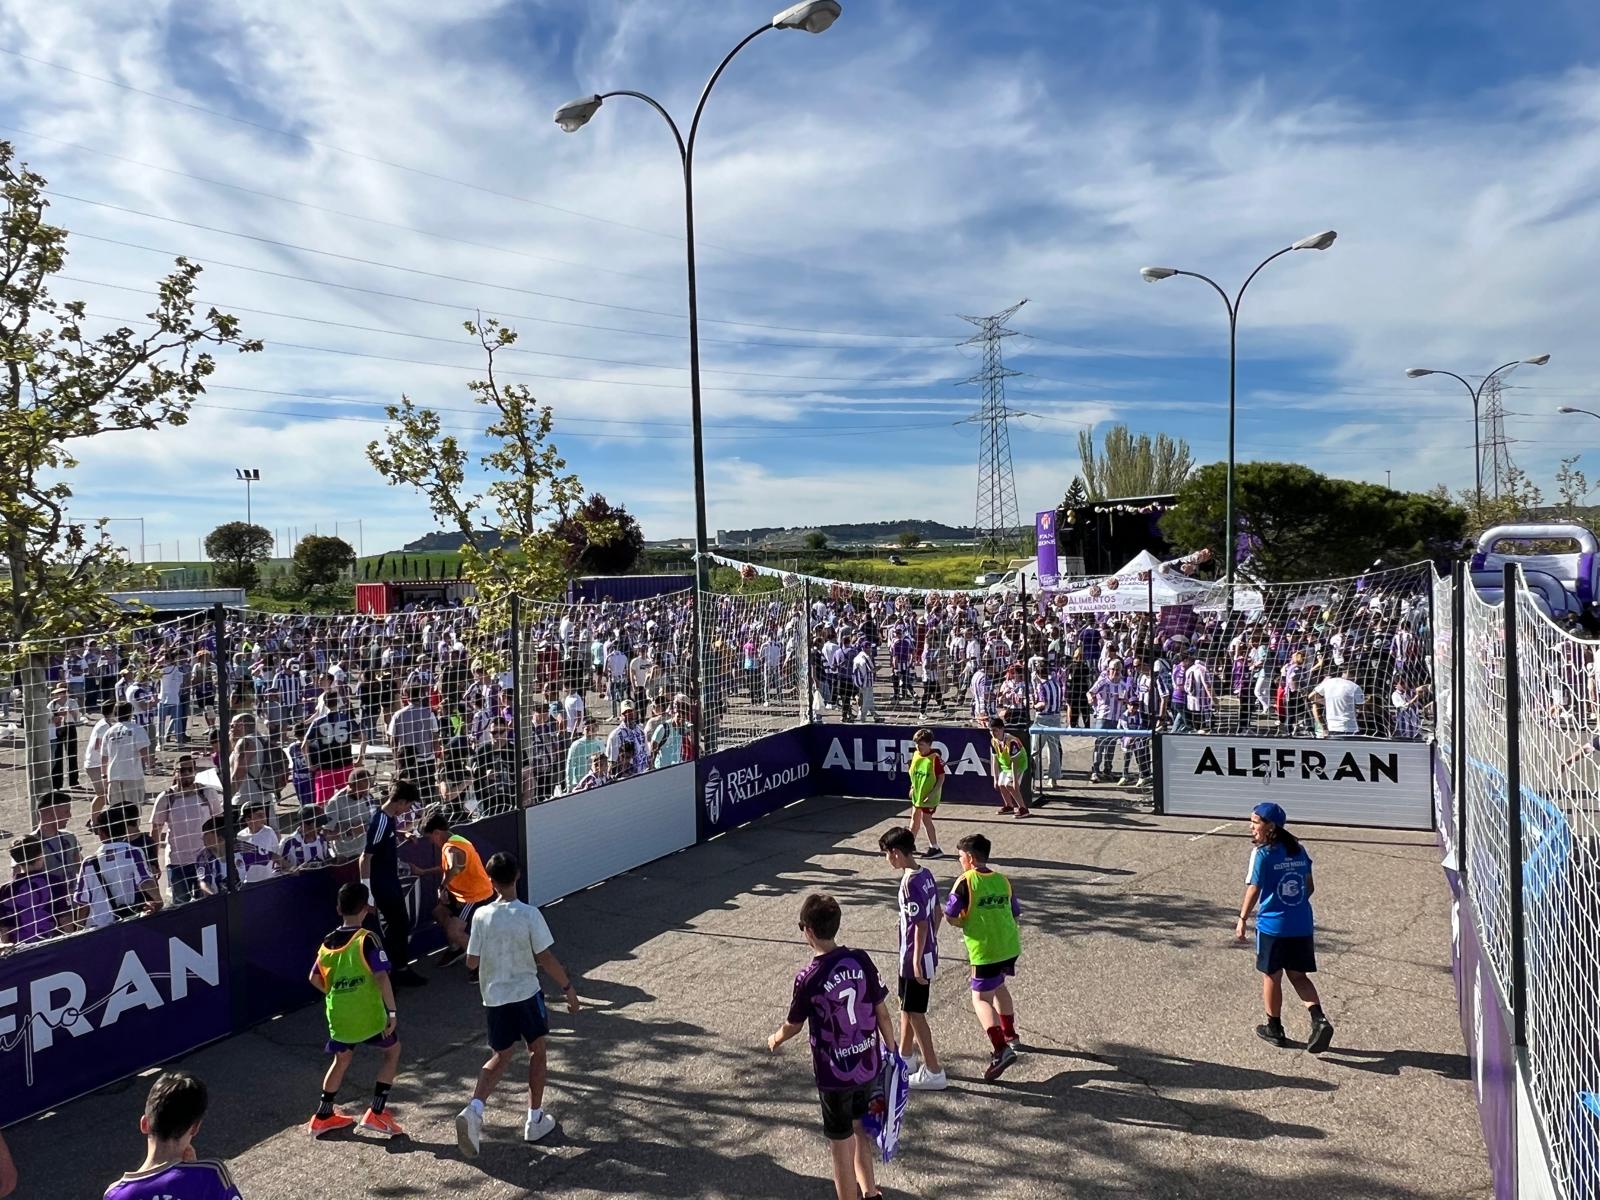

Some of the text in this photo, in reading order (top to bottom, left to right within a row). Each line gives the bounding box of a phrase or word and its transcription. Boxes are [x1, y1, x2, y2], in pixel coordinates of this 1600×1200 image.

[1068, 595, 1116, 605] ALIMENTOS
[1079, 603, 1117, 611] VALLADOLID
[1194, 746, 1399, 783] ALEFRAN
[727, 764, 763, 792] REAL
[728, 763, 810, 804] VALLADOLID
[823, 969, 864, 993] M.SYLLA
[838, 987, 857, 1025] 7
[834, 1037, 876, 1061] Herbalife
